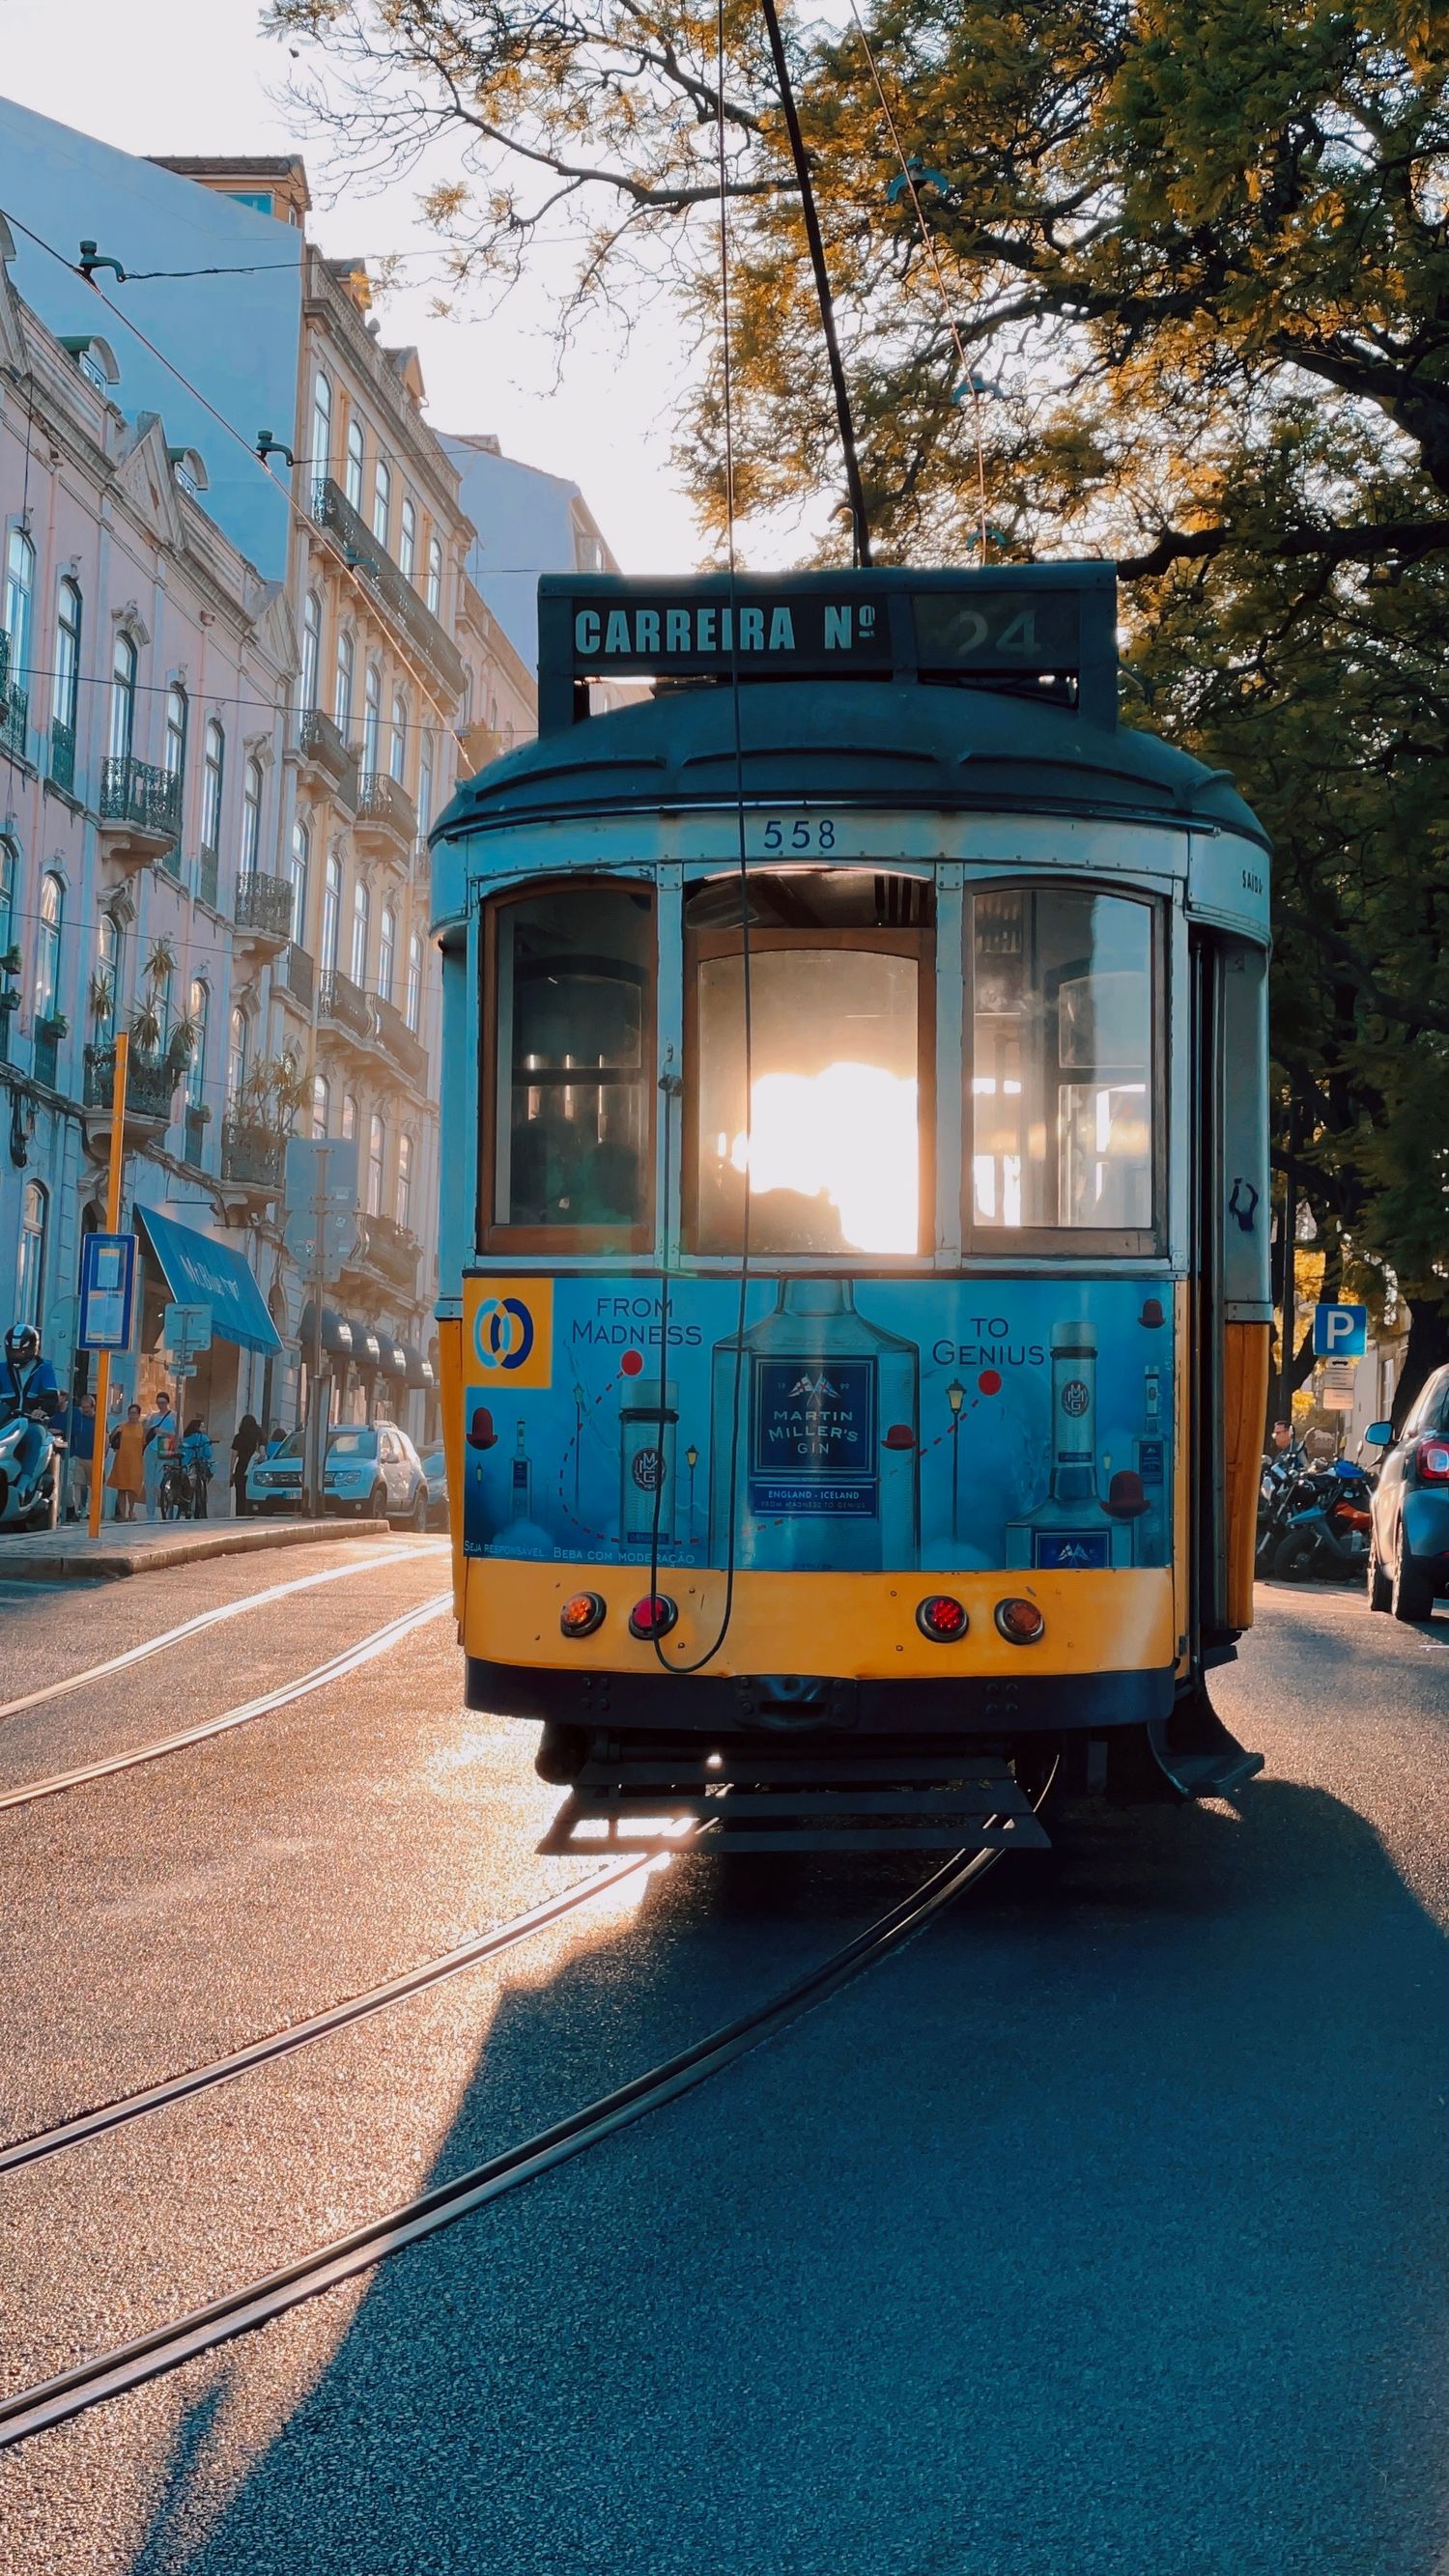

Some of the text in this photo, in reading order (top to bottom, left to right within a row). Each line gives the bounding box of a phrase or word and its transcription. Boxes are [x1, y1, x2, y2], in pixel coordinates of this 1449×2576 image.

[575, 607, 796, 654] CARREIRA
[949, 609, 1042, 658] 24
[763, 819, 836, 849] 558
[596, 1297, 673, 1318] FROM
[571, 1319, 703, 1346] MADNESS
[970, 1317, 1009, 1338] TO
[1326, 1311, 1354, 1349] P
[932, 1340, 1045, 1366] GENIUS
[773, 1410, 854, 1422] MARTIN
[768, 1425, 860, 1443] MILLER'S
[797, 1442, 830, 1455] GIN
[768, 1490, 812, 1499] ENGLAND
[464, 1540, 482, 1552] SEJA
[554, 1546, 582, 1560] BEBA
[587, 1550, 612, 1561] COM
[618, 1551, 695, 1566] MODERAÇÃO
